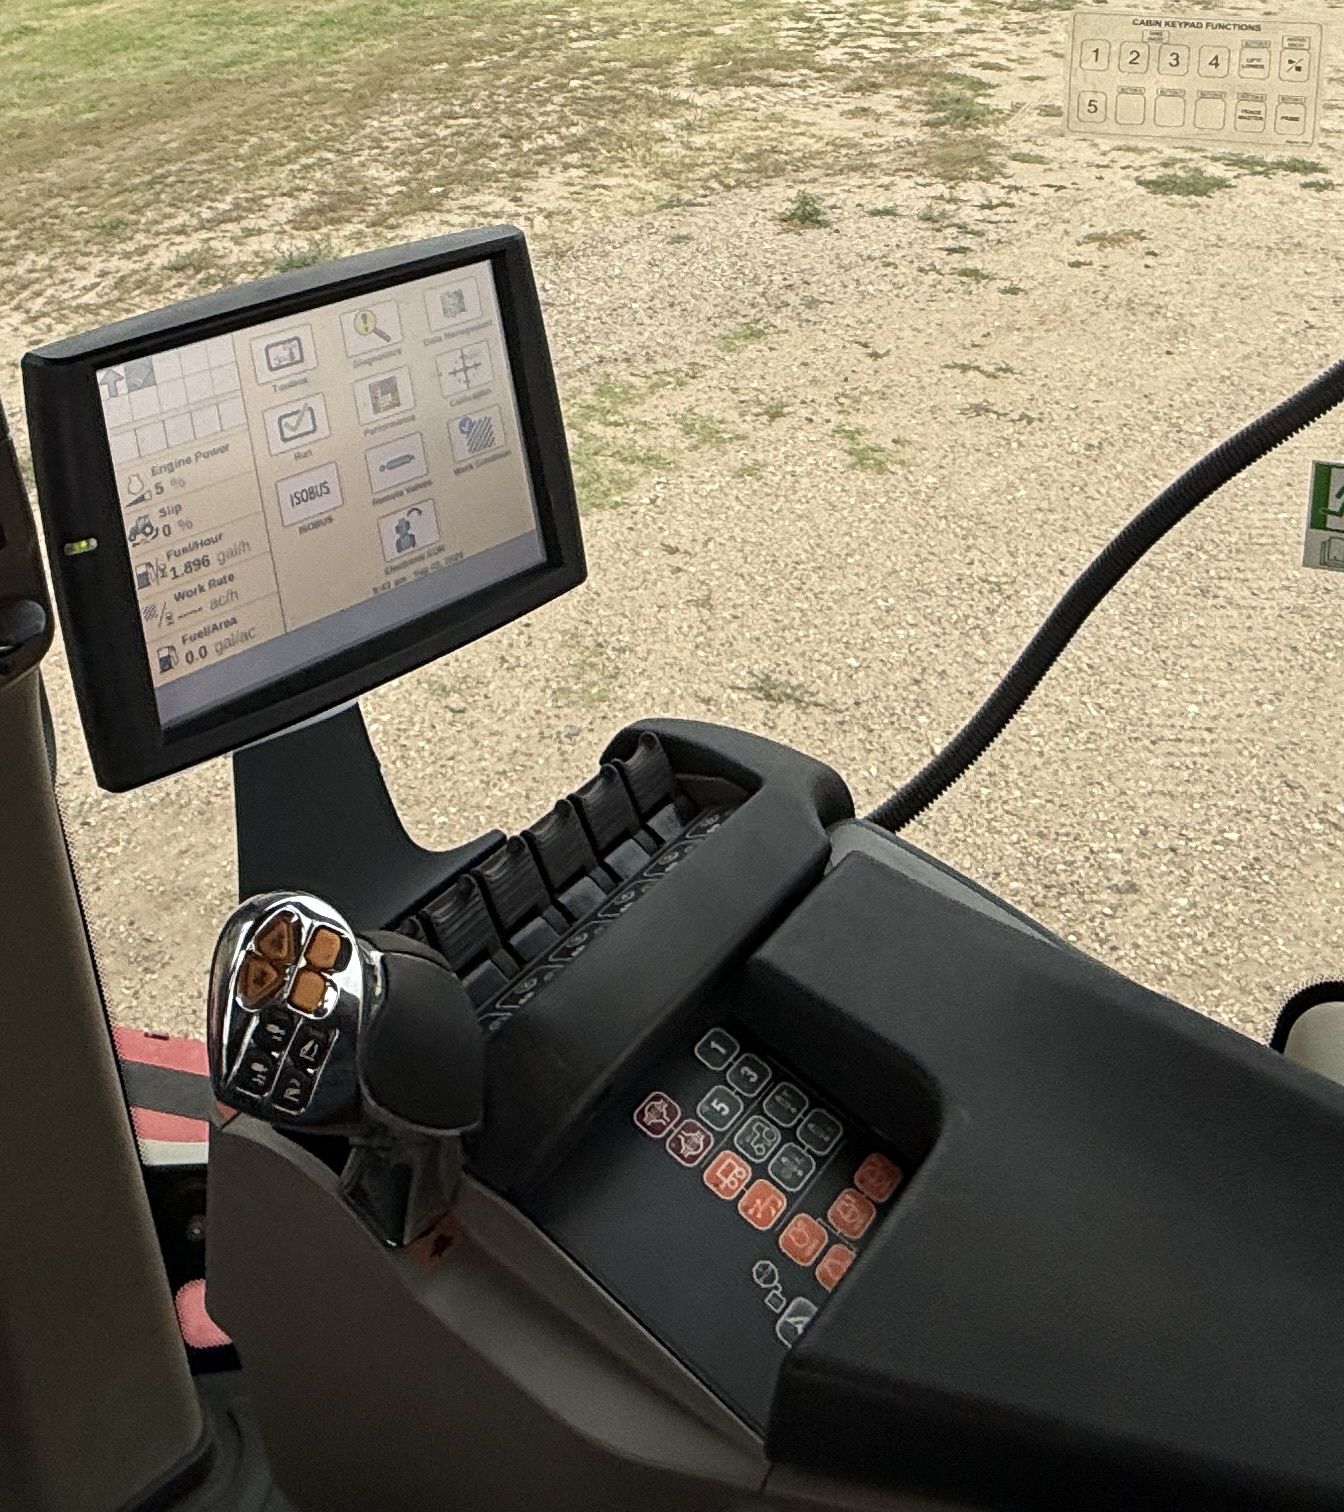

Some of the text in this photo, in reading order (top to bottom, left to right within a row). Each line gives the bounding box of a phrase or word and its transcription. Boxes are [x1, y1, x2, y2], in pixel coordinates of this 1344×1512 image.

[1132, 18, 1262, 32] CABIN KEYPAD FUNCTIONS
[1092, 48, 1100, 63] 1
[1128, 49, 1141, 65] 2
[1168, 52, 1180, 68] 3
[1208, 54, 1220, 69] 4
[1087, 99, 1098, 114] 5
[151, 443, 230, 477] Engine Power
[294, 449, 313, 461] Run
[154, 476, 187, 496] 5 %
[289, 479, 331, 508] ISOBUS
[158, 503, 183, 519] Slip
[162, 518, 194, 538] 0 %
[166, 532, 224, 562] Fuel/Hour
[169, 554, 211, 581] 1.896
[174, 572, 236, 603] Work Rate
[181, 615, 238, 646] Fuel/Area
[185, 644, 208, 666] 0.0
[709, 1040, 727, 1056] 1
[740, 1065, 759, 1084] 3
[710, 1097, 731, 1117] 5
